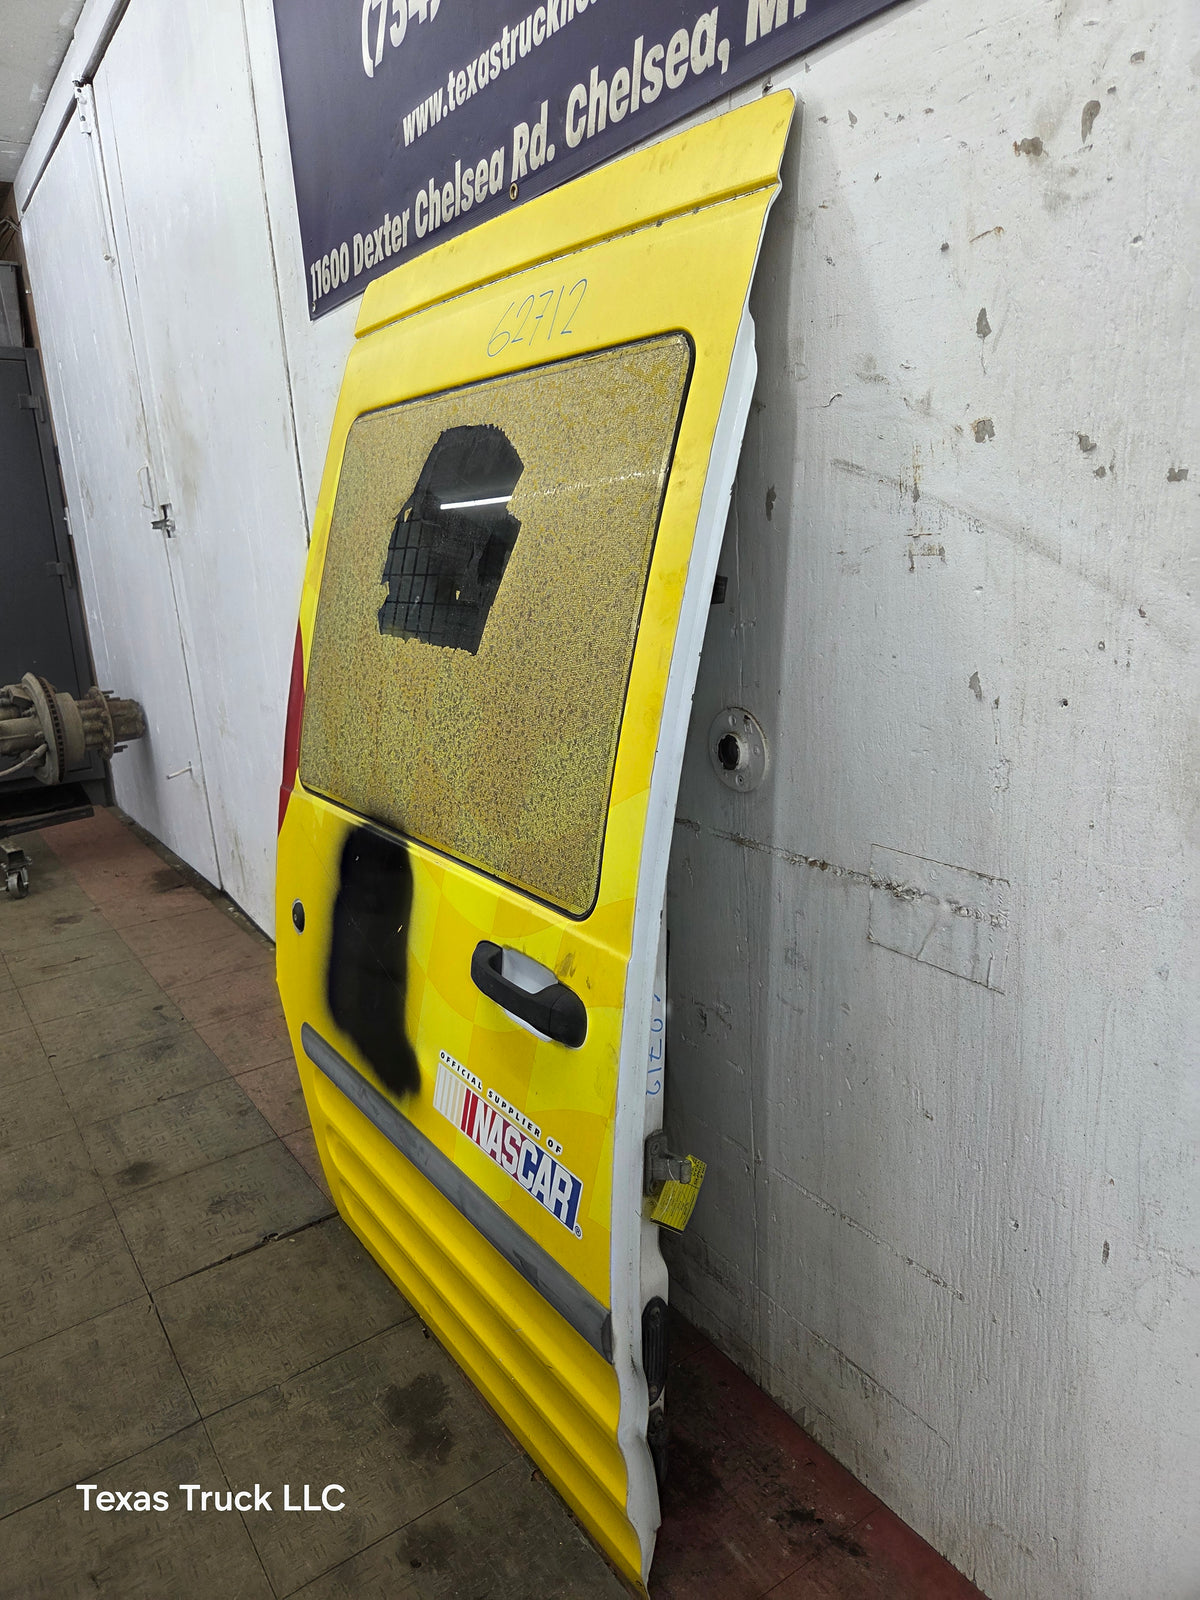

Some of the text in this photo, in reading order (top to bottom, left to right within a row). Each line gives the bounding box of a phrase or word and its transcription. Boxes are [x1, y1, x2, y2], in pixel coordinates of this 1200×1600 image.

[310, 241, 349, 301] 11600
[353, 208, 410, 277] Dexter
[415, 146, 505, 238] Chelsea
[510, 100, 556, 184] Rd.
[565, 6, 730, 148] Chelsea,
[487, 278, 588, 357] 62712
[440, 1051, 562, 1153] OFFICIAL SUPPLIER OF
[472, 1097, 573, 1224] NASCAR
